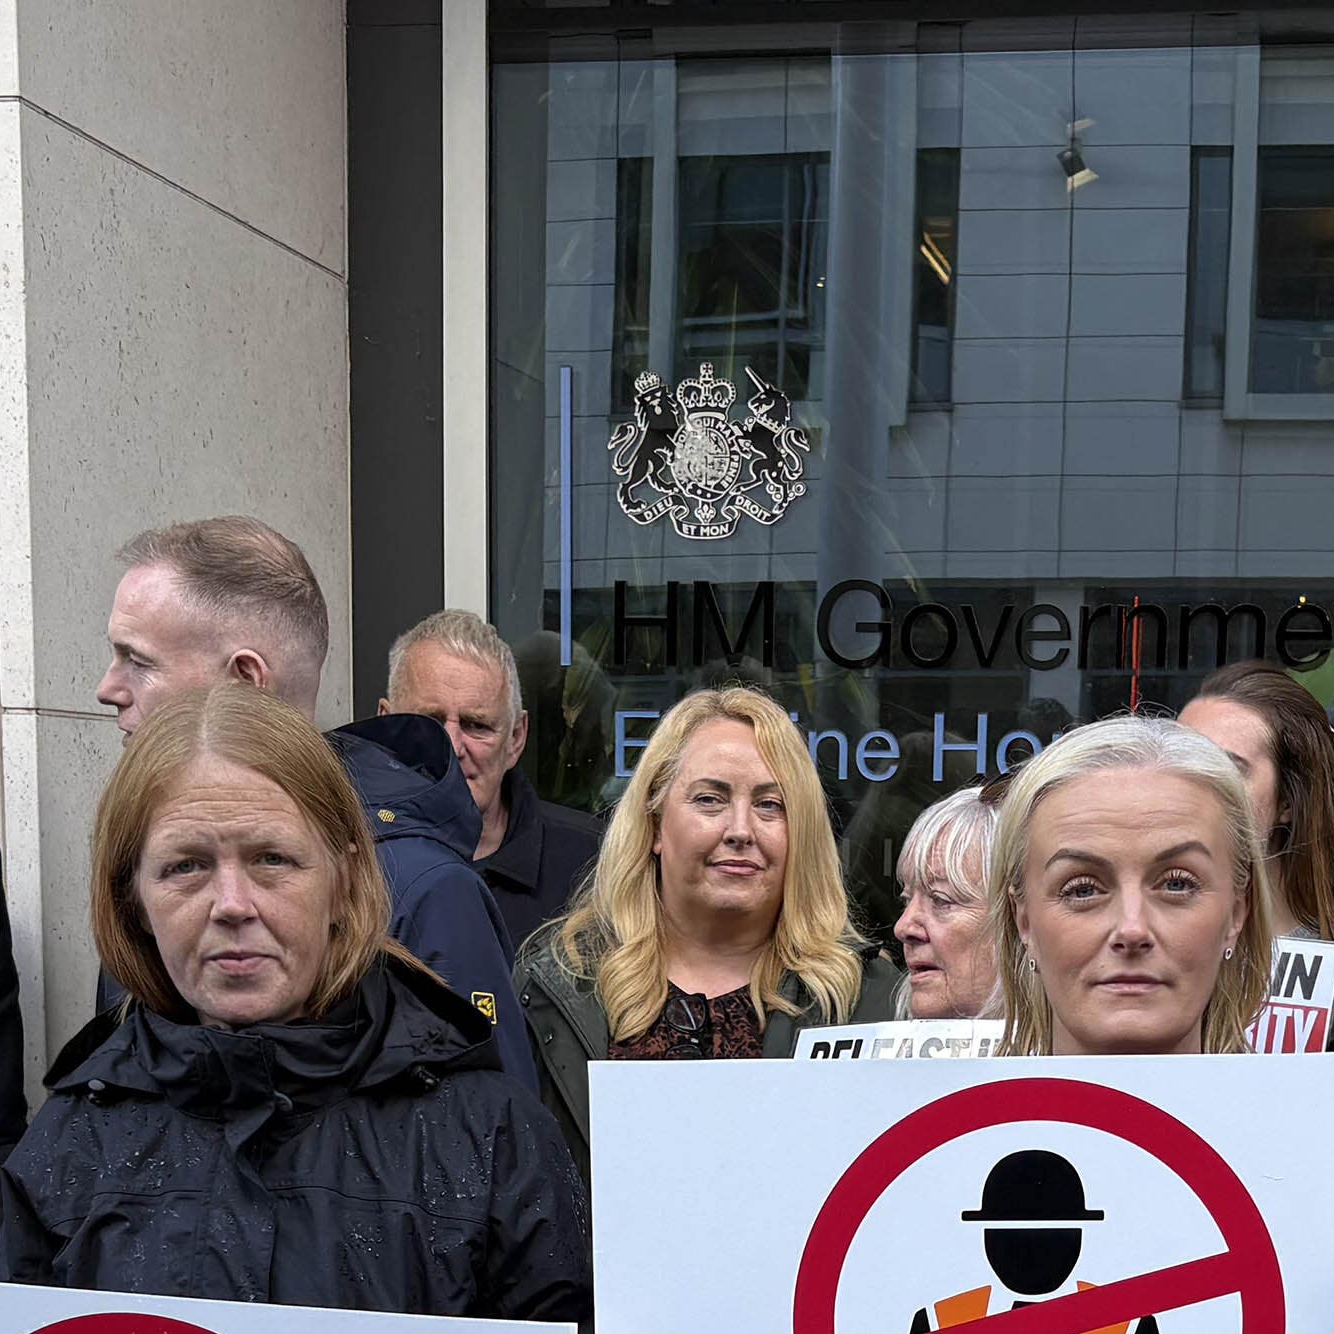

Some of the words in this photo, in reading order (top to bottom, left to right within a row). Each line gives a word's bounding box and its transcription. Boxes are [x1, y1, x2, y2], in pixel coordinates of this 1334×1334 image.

[644, 495, 674, 521] DIEU
[735, 495, 771, 522] DROIT
[682, 524, 697, 535] ET
[700, 524, 730, 537] MON
[614, 580, 774, 667] HM
[1271, 952, 1324, 1000] IN
